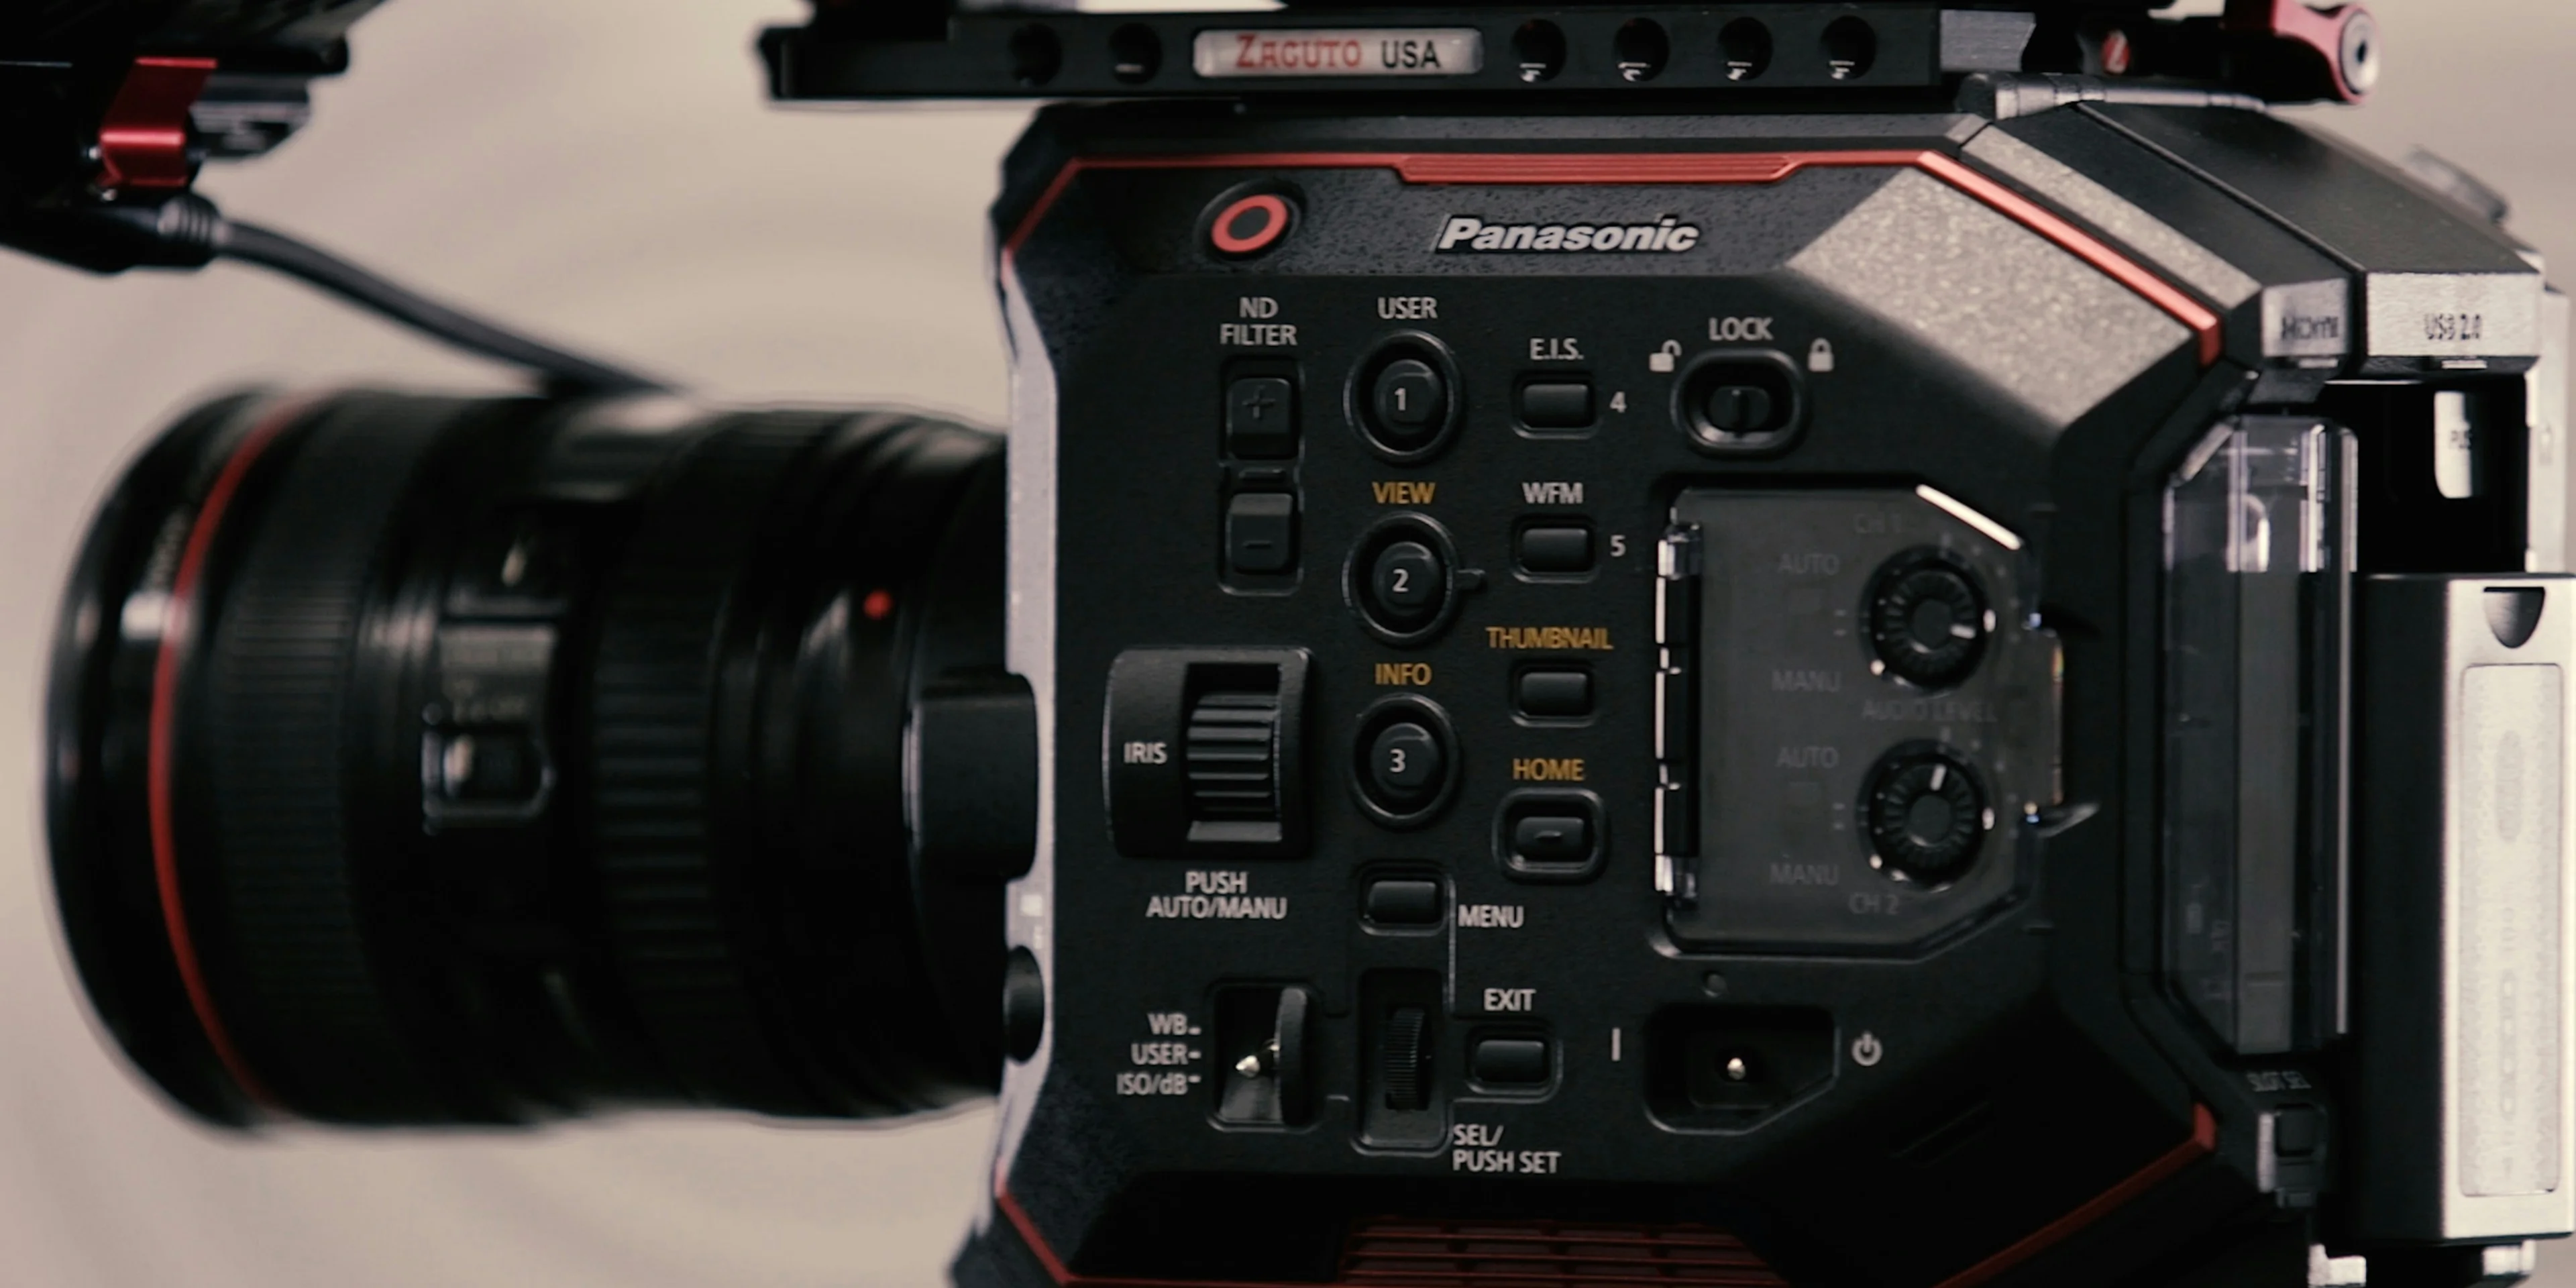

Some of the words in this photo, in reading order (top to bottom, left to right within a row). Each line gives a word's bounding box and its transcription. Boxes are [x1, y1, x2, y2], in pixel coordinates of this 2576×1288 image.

[1381, 40, 1442, 68] USA
[1438, 217, 1700, 252] Panasonic
[1240, 297, 1279, 319] ND
[1377, 297, 1438, 319] USER
[1220, 323, 1297, 346] FILTER
[1709, 317, 1773, 341] LOCK
[1529, 337, 1584, 361] E.I.S.
[1394, 387, 1406, 411] 1
[1609, 390, 1627, 413] 4
[1372, 482, 1436, 504] VIEW
[1522, 482, 1584, 504] WFM
[1610, 535, 1626, 557] 5
[1777, 553, 1840, 576] AUTO
[1392, 568, 1409, 593] 2
[1485, 626, 1614, 650] THUMBNAIL
[1375, 663, 1432, 686] INFO
[1772, 669, 1842, 693] MANU
[1124, 741, 1167, 765] IRIS
[1389, 749, 1406, 773] 3
[1775, 747, 1839, 769] AUTO
[1513, 757, 1585, 782] HOME
[1185, 871, 1247, 894] PUSH
[1769, 863, 1840, 885] MANU
[1146, 895, 1287, 920] AUTO/MANU
[1884, 893, 1900, 915] 2
[1458, 904, 1524, 928] MENU
[1483, 987, 1536, 1012] EXIT
[1148, 1012, 1187, 1036] WB
[1131, 1042, 1187, 1065] USER
[1117, 1073, 1187, 1095] ISO/dB
[1453, 1124, 1504, 1147] SEL/
[1452, 1150, 1515, 1173] PUSH
[1519, 1151, 1562, 1174] SET
